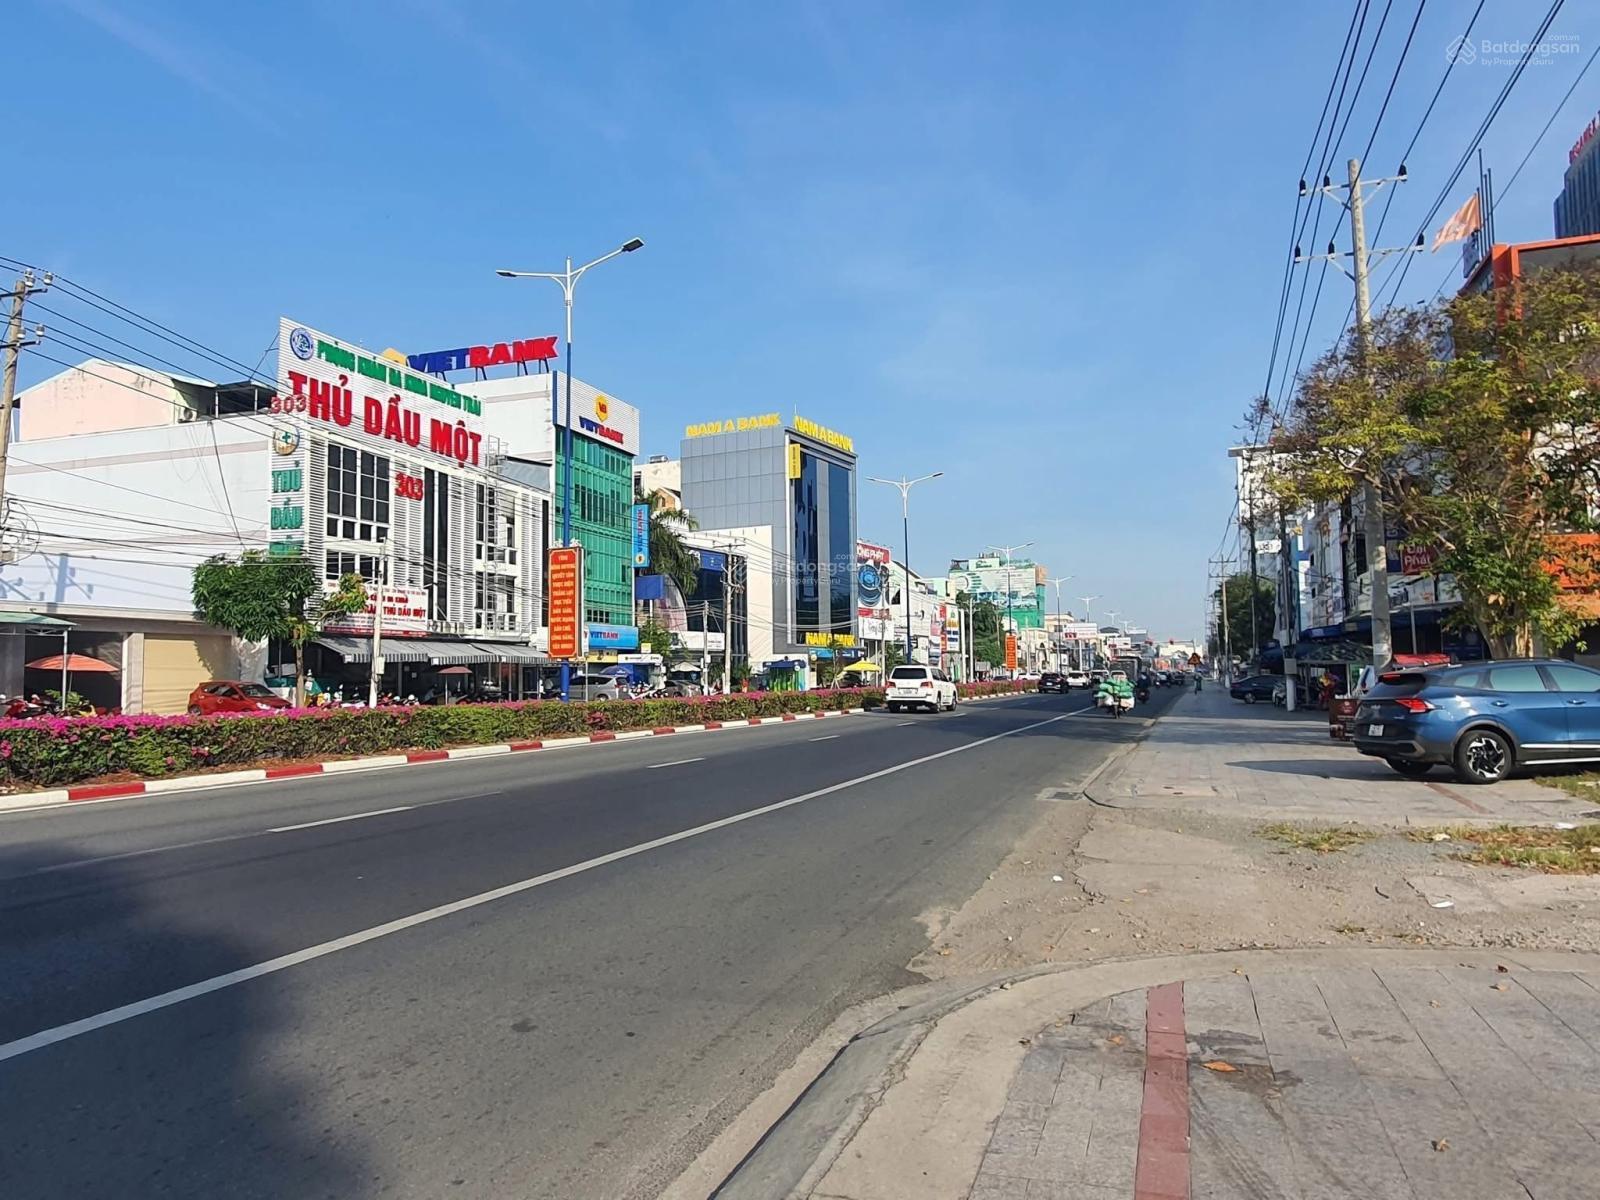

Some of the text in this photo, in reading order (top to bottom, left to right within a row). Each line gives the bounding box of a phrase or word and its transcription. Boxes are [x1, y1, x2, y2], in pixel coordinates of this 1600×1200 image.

[406, 336, 559, 373] VIETBANK
[271, 394, 308, 414] 303
[288, 370, 482, 468] THỦ DẦU MỘT
[579, 416, 624, 445] VIETBANK
[686, 422, 721, 438] NAM
[738, 412, 781, 431] BANK
[394, 471, 424, 501] 303
